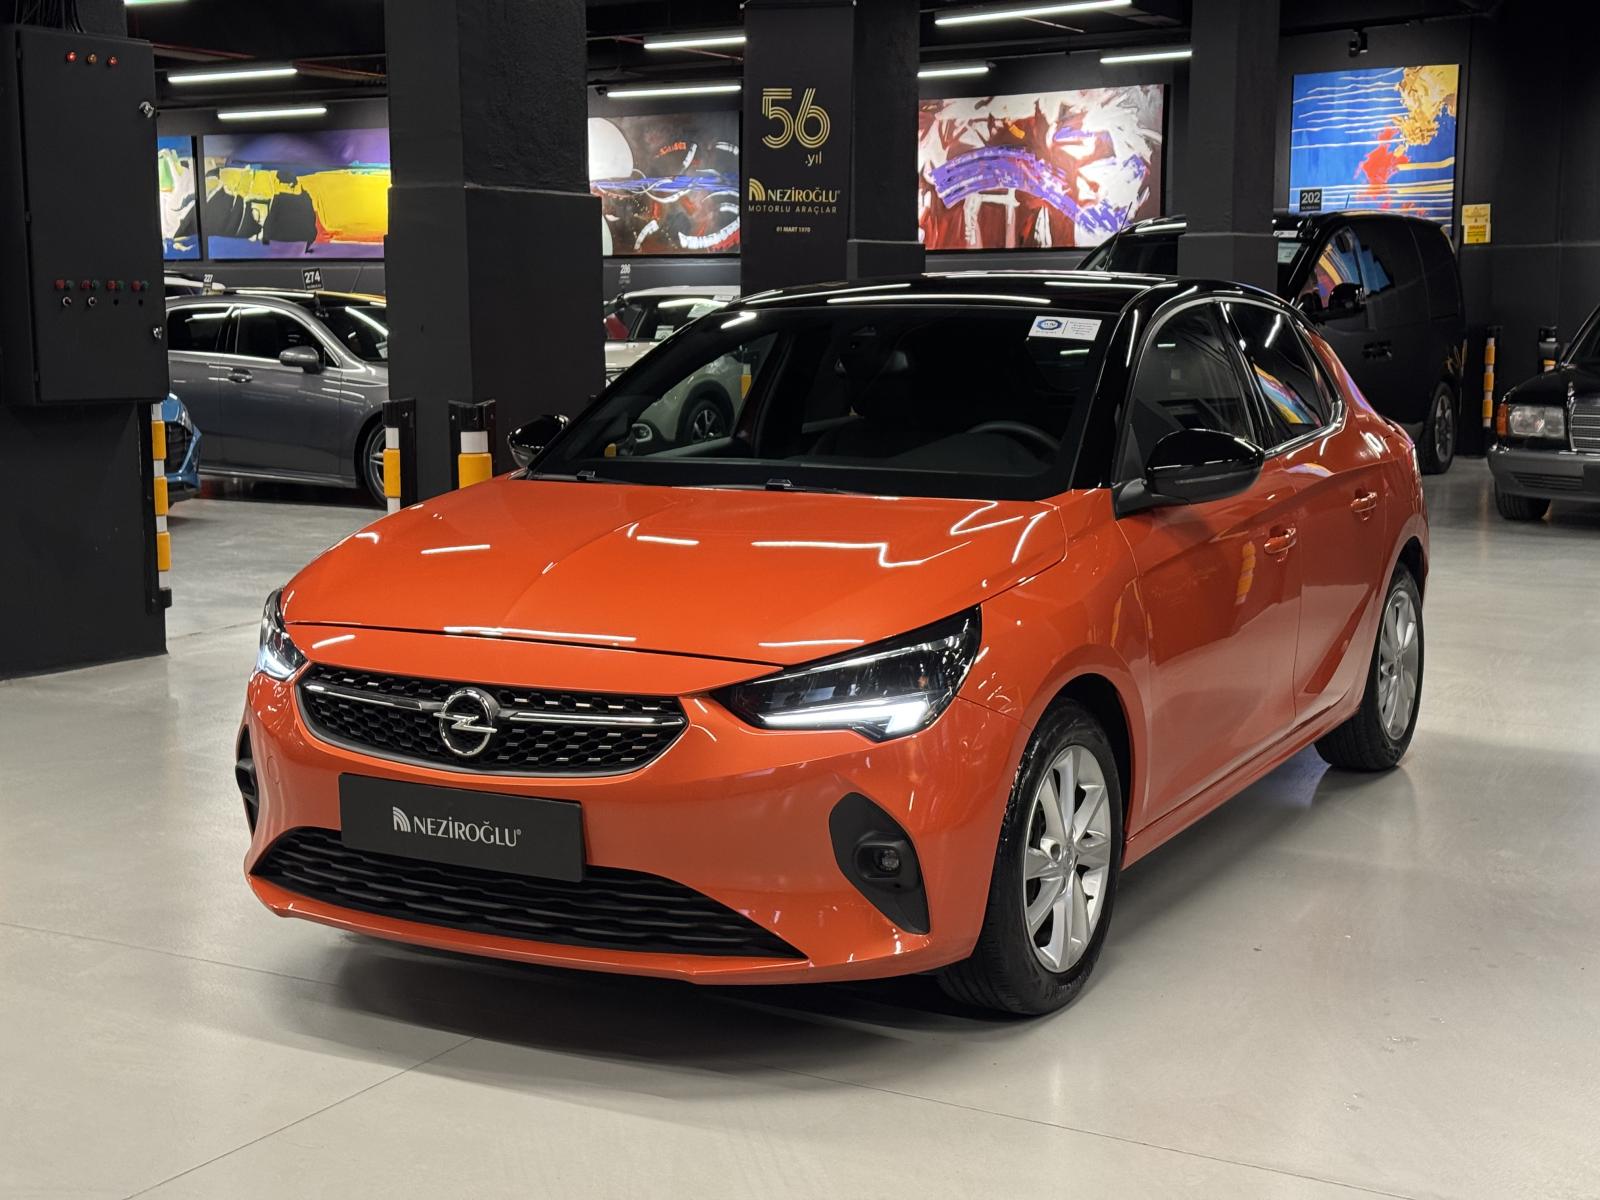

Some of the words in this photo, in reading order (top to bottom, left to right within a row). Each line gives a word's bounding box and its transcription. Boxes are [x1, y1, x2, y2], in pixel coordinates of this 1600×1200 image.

[762, 87, 831, 149] 56
[1301, 191, 1321, 204] 202
[748, 204, 791, 213] MOTORLU
[795, 205, 837, 216] ARAÇLAR
[304, 270, 320, 284] 274
[413, 815, 518, 847] NEZİROĞLU
